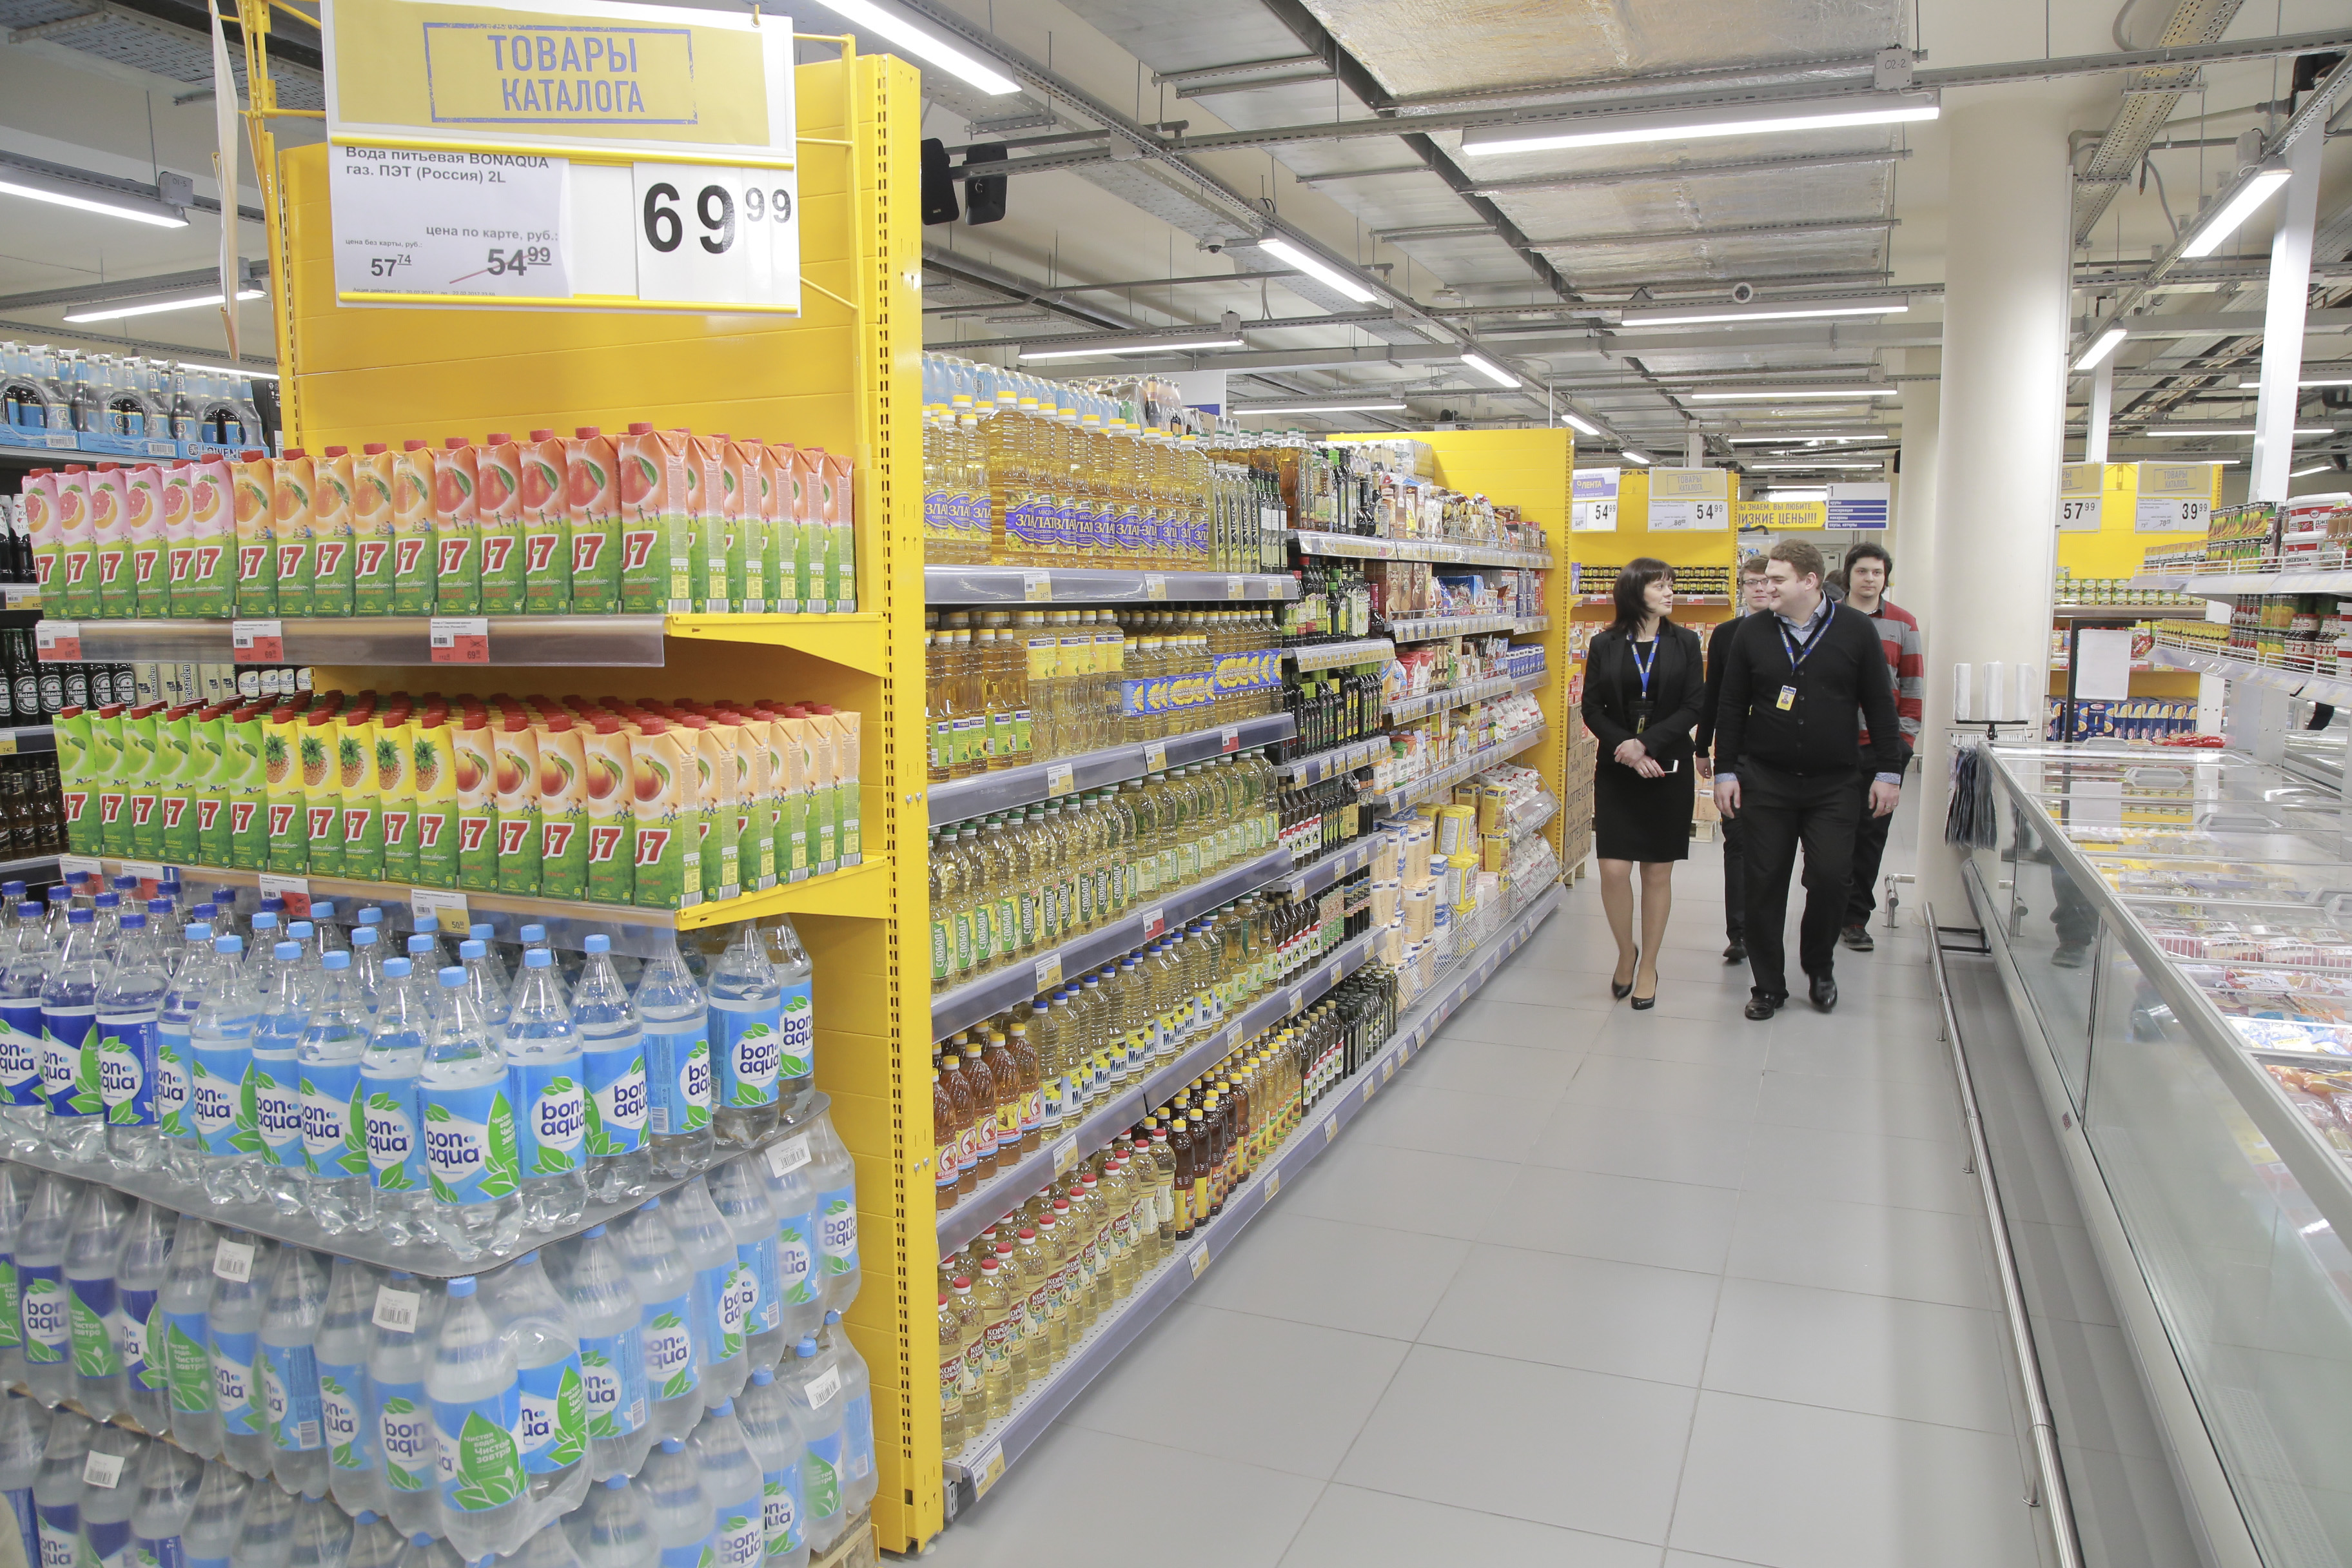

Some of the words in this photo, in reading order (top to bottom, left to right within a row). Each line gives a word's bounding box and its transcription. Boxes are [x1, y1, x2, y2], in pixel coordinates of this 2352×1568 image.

[487, 35, 637, 73] ТОВАРЫ
[502, 78, 645, 113] КАТАЛОГА
[346, 146, 386, 160] Вода
[391, 151, 464, 164] питьевая
[469, 153, 549, 169] BONAQUA
[346, 165, 375, 176] газ.
[379, 164, 411, 178] ПЭТ
[416, 166, 484, 184] (Россия)
[488, 171, 506, 183] 2L
[643, 183, 735, 254] 69
[426, 226, 458, 237] цена
[462, 228, 479, 237] по
[483, 229, 523, 240] карте,
[527, 230, 558, 243] руб.:
[379, 240, 404, 249] карты,
[371, 259, 397, 277] 57
[1678, 475, 1701, 484] ТОВАРЫ
[2164, 470, 2188, 479] ТОВАРЫ
[1582, 480, 1602, 489] ЛЕНТА
[1830, 486, 1834, 496] 1
[2165, 480, 2188, 488] КАТАЛОГА
[925, 504, 948, 514] ЗЛА
[948, 505, 970, 516] ЗЛА
[974, 508, 991, 518] ЗЛА
[1596, 505, 1608, 520] 54
[1697, 504, 1714, 520] 54
[2064, 503, 2083, 520] 57
[2182, 503, 2197, 520] 39
[1015, 514, 1034, 526] ЗЛА
[1778, 513, 1817, 524] ЦЕНЫ!!!
[1094, 523, 1115, 534] ЗЛА
[1116, 524, 1139, 535] ЗЛАТ
[181, 665, 193, 703] oegaarden
[1583, 741, 1595, 758] LOTTE
[1581, 779, 1593, 796] LOTTE
[1567, 788, 1581, 808] LOTTE
[1579, 818, 1591, 837] LOTTE
[1566, 826, 1580, 848] LOTTE
[101, 1061, 121, 1075] on
[101, 1075, 135, 1092] qua
[194, 1100, 231, 1121] qua
[1048, 1274, 1064, 1284] КОРО
[28, 1317, 66, 1332] aqu
[987, 1324, 1009, 1335] КОРОН
[940, 1362, 961, 1375] КОРОН
[387, 1438, 424, 1457] aqu
